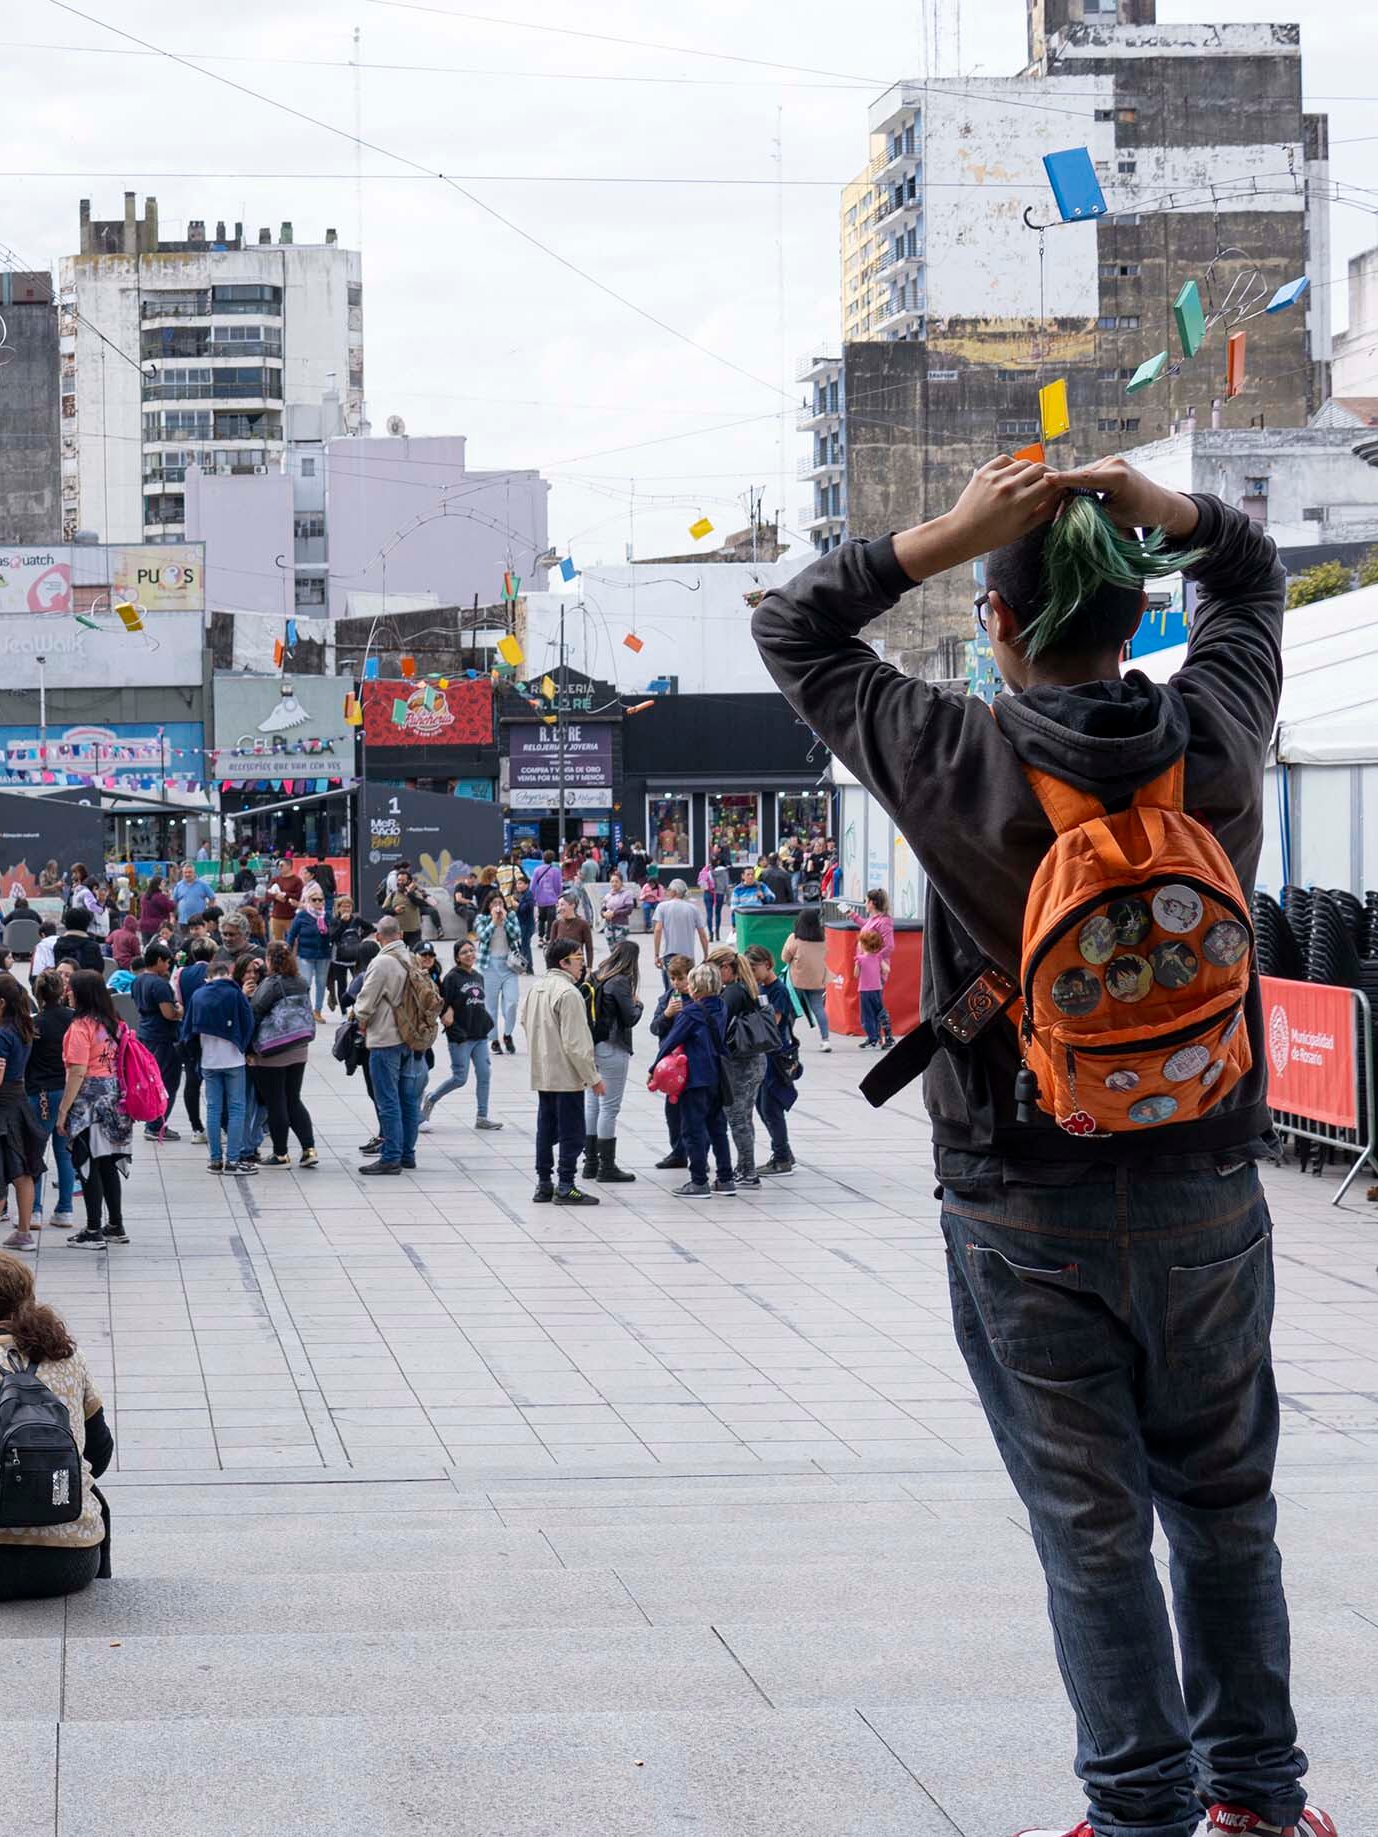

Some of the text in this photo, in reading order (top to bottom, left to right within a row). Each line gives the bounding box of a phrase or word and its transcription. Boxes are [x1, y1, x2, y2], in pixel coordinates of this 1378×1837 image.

[530, 684, 596, 694] REOJERIA
[552, 726, 582, 742] LRE
[551, 774, 576, 782] MAOR
[388, 797, 401, 814] 1
[1291, 1027, 1335, 1050] Municipalidad
[1300, 1048, 1324, 1067] Rosario
[1216, 1809, 1251, 1828] NIKE
